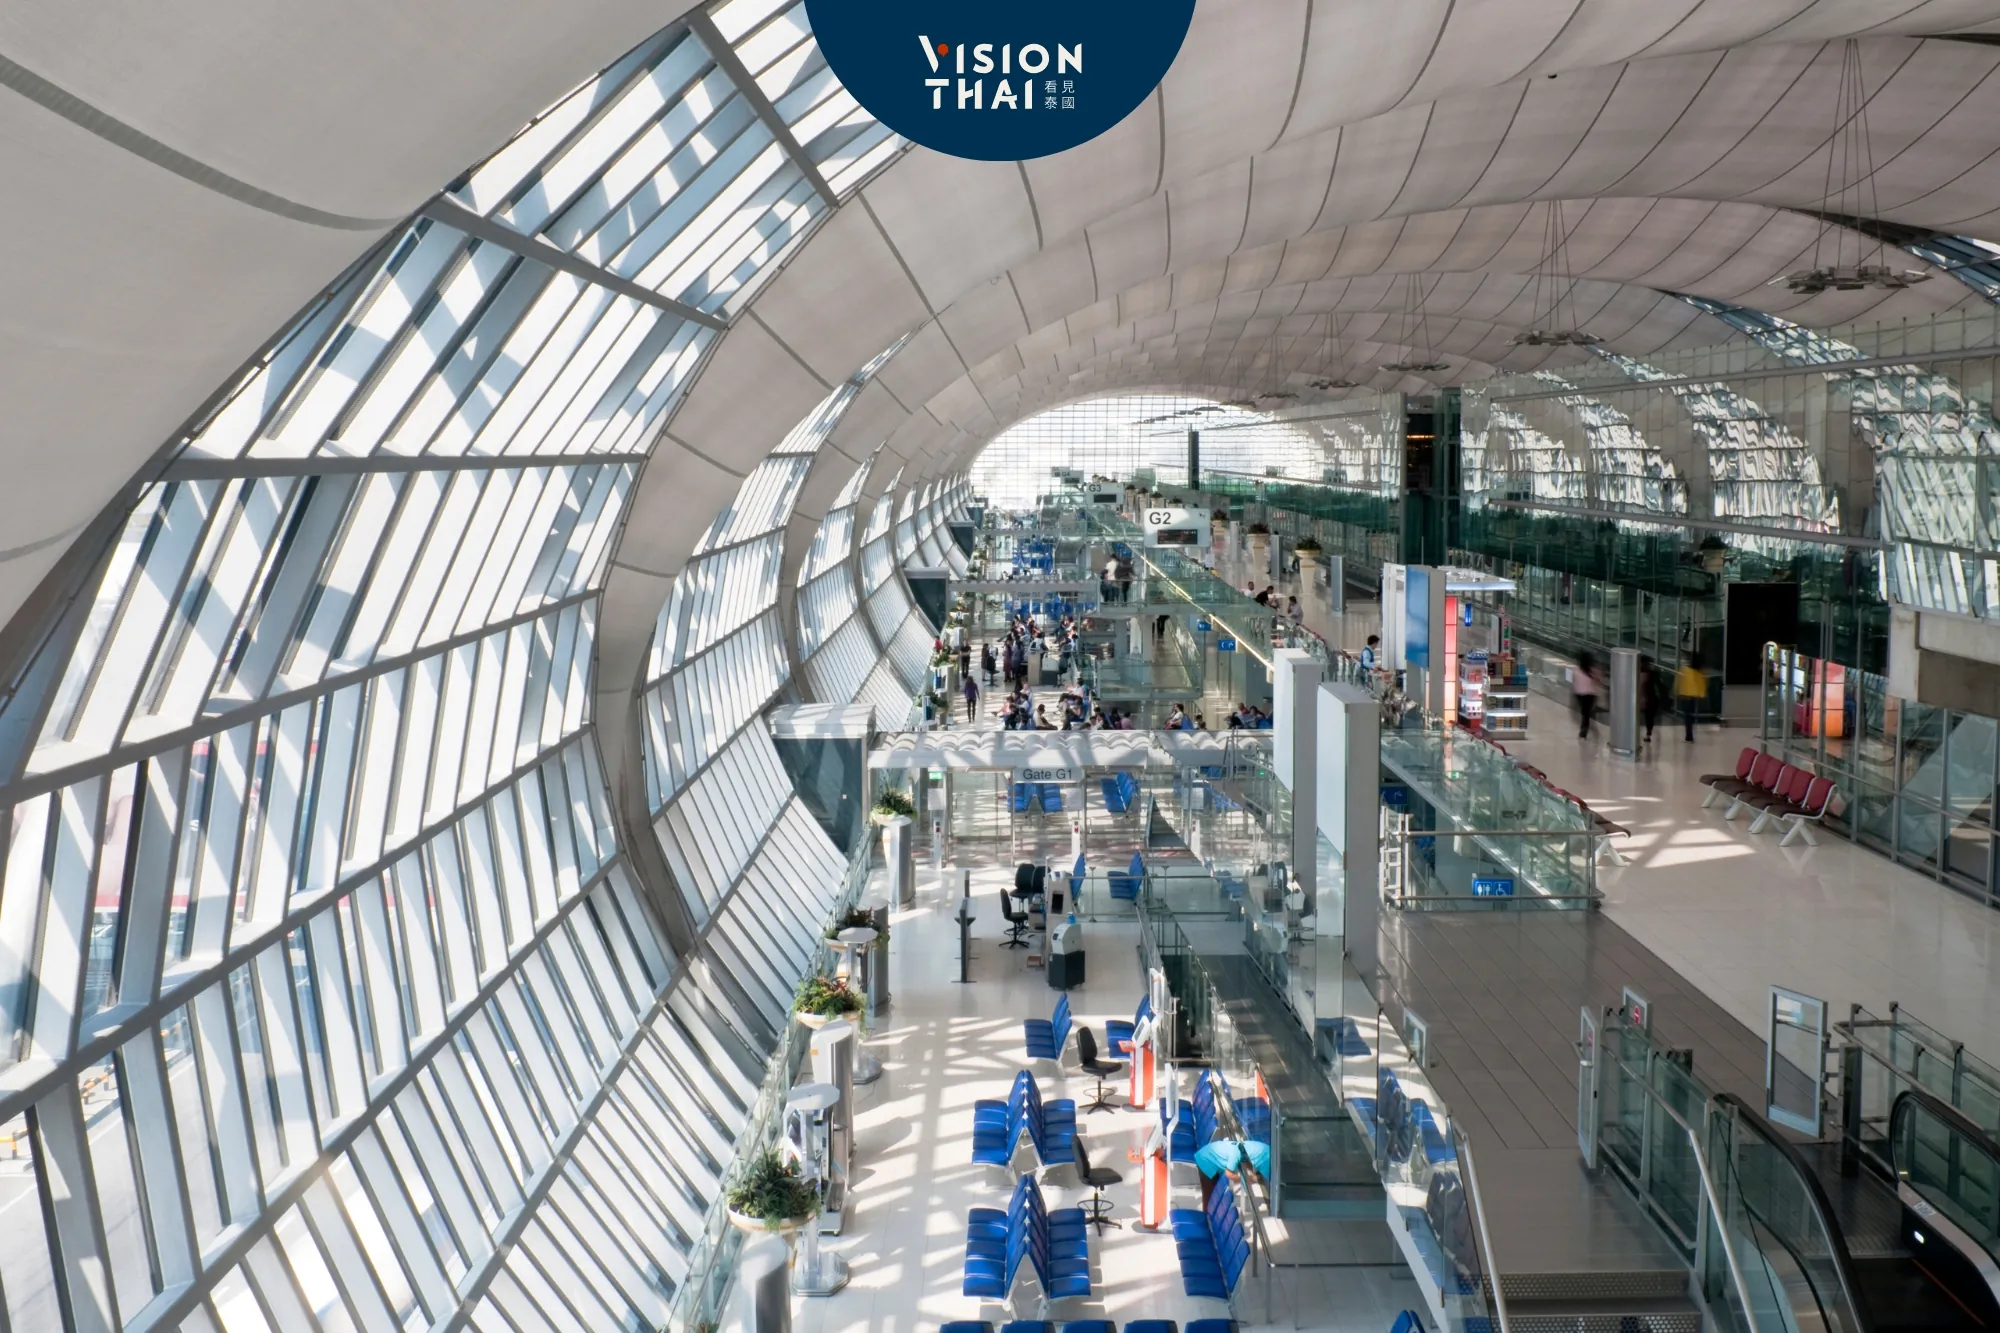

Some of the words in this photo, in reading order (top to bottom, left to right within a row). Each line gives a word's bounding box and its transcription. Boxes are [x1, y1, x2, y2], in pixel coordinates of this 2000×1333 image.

[1089, 484, 1101, 492] G3
[1149, 511, 1171, 525] G2
[1023, 768, 1052, 780] Gate
[1056, 768, 1072, 780] G1
